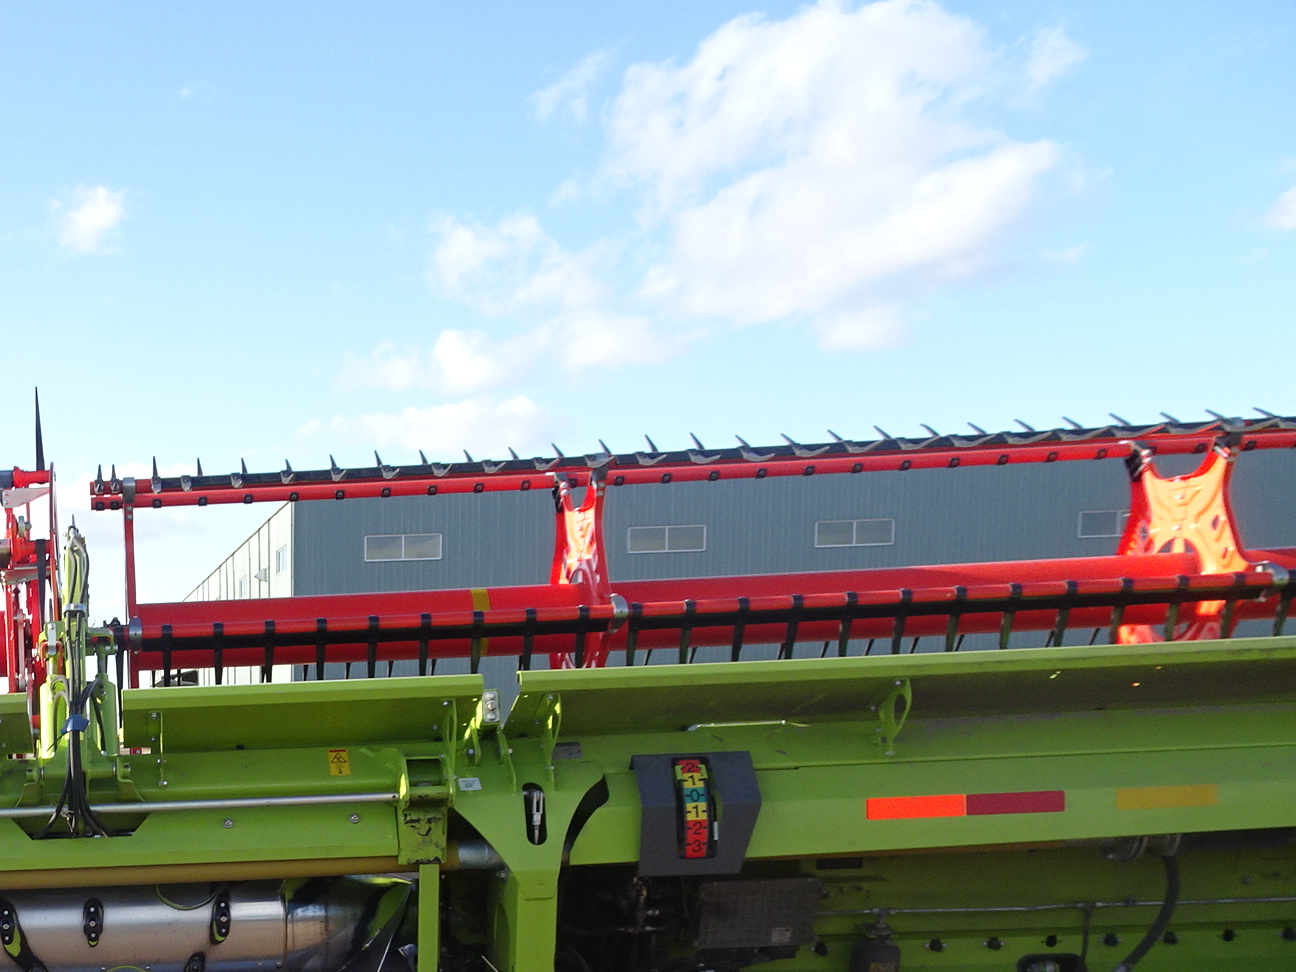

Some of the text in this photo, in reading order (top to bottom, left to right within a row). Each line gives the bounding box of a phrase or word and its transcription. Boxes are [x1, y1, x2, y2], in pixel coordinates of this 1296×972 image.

[685, 762, 696, 773] 2
[688, 775, 696, 786] 1
[692, 805, 700, 818] 1
[693, 821, 703, 835] 2
[692, 839, 702, 853] 3
